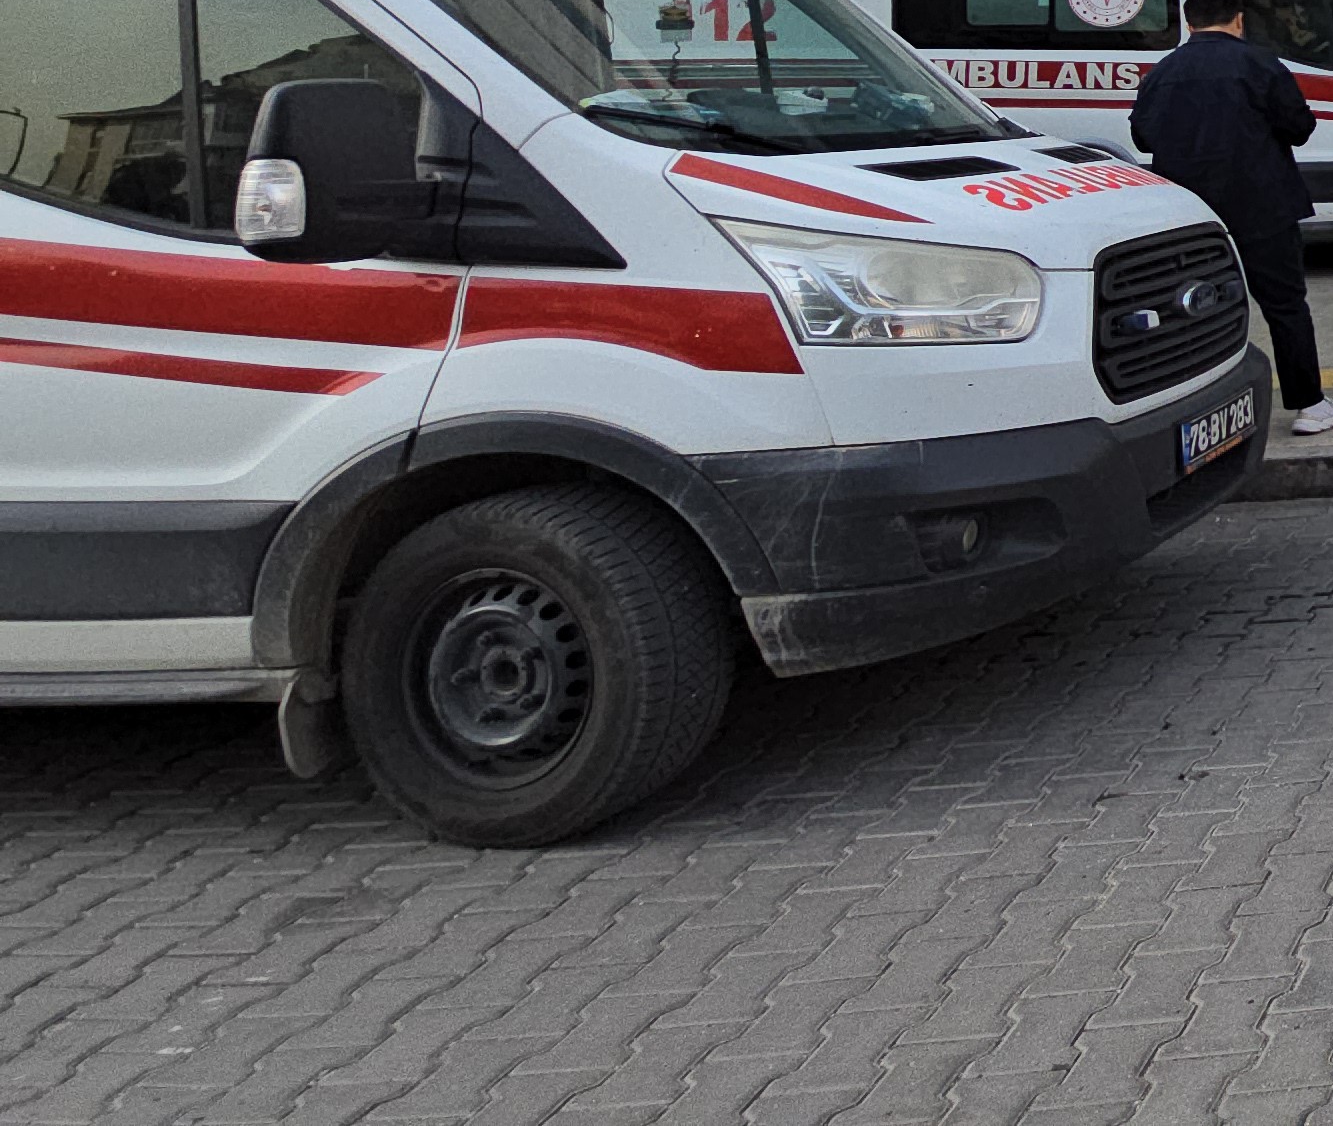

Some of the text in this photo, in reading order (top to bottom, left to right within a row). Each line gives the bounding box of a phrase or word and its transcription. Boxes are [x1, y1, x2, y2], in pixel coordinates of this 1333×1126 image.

[932, 60, 1141, 90] MBULANS
[1189, 419, 1209, 458] 78
[1210, 407, 1229, 446] BV
[1229, 394, 1252, 434] 283
